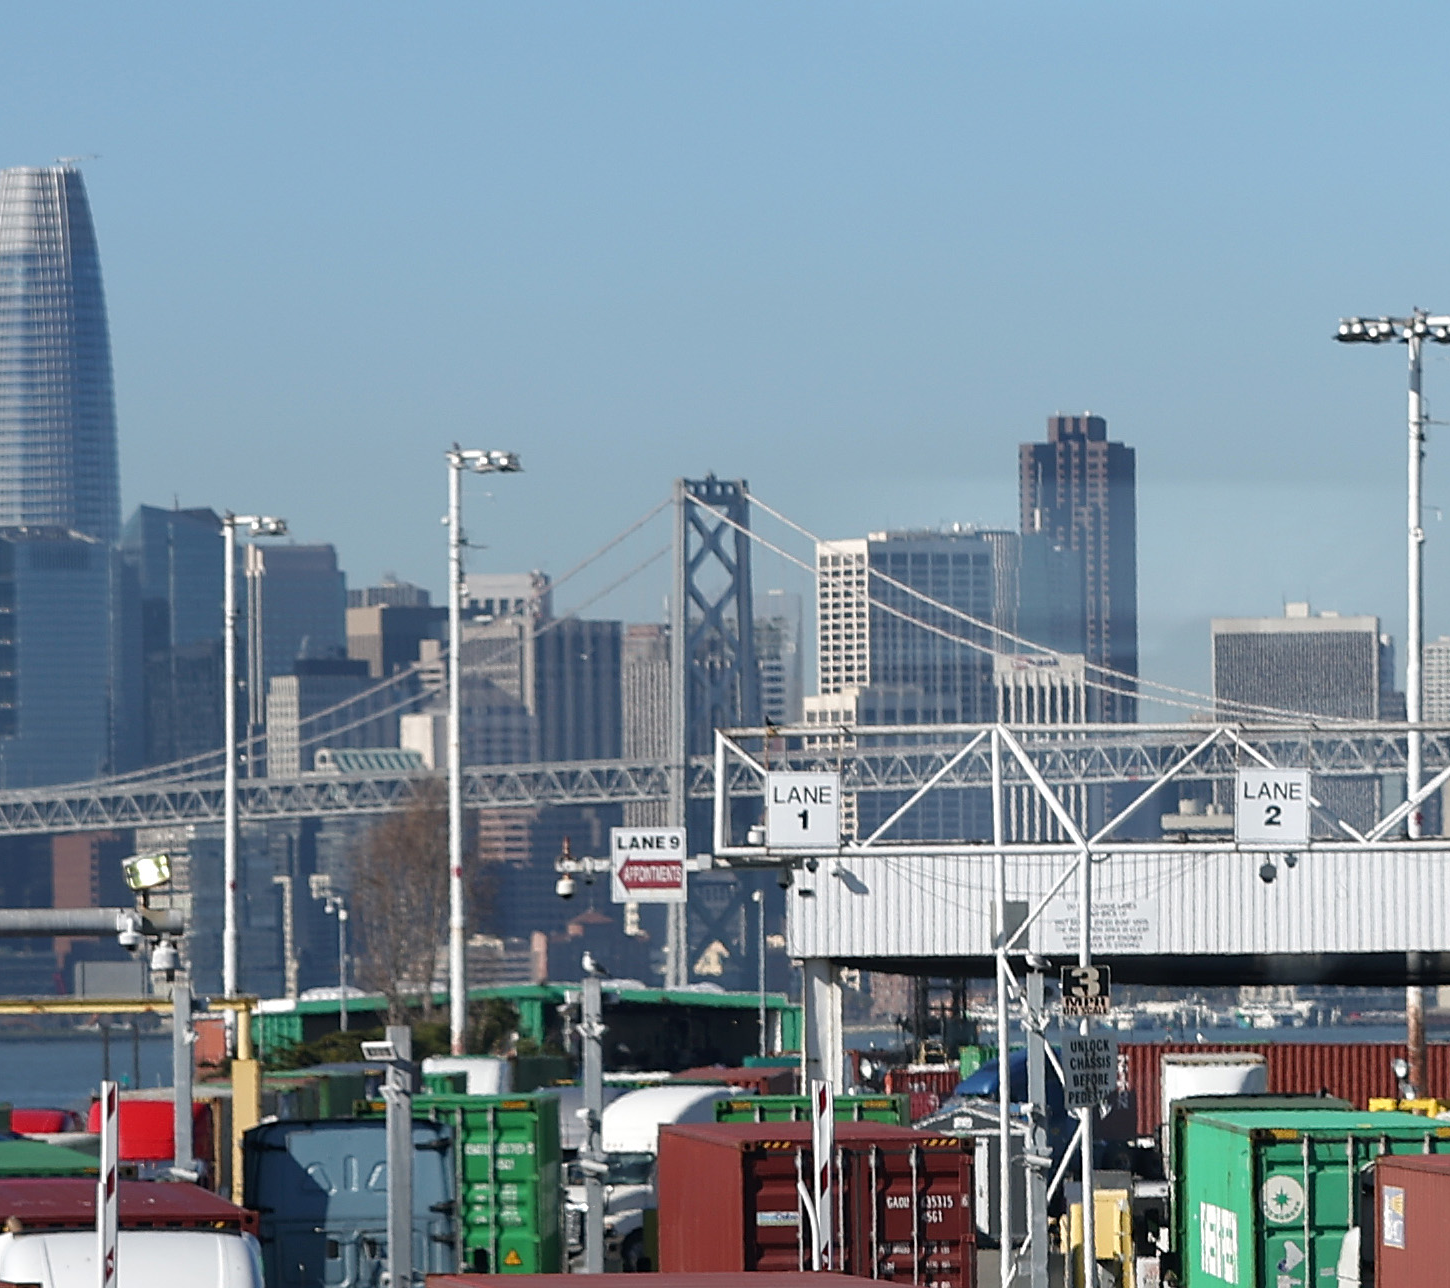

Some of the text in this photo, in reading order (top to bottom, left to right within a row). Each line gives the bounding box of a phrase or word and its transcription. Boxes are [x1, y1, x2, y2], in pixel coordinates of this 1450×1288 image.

[773, 785, 832, 804] LANE
[1243, 781, 1303, 800] LANE
[798, 810, 809, 830] 1
[1264, 805, 1282, 826] 2
[618, 836, 680, 849] LANE 9
[1071, 966, 1100, 997] 3
[1070, 1039, 1110, 1053] UNLOCK
[1070, 1055, 1111, 1070] CHASSIS
[1072, 1071, 1109, 1087] BEFORE
